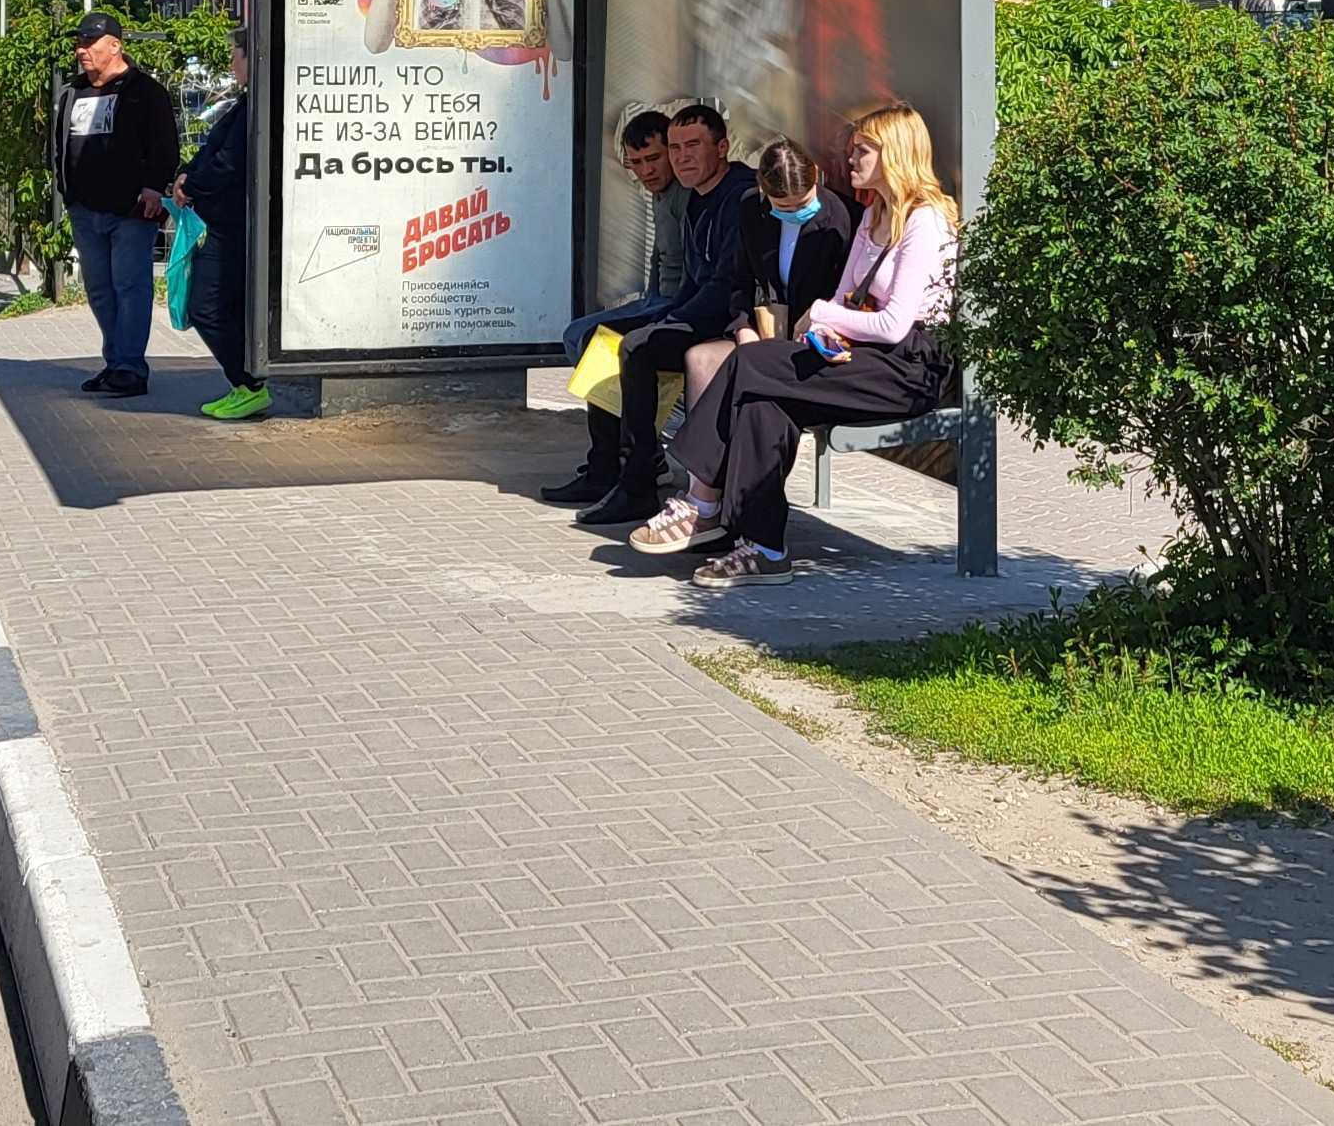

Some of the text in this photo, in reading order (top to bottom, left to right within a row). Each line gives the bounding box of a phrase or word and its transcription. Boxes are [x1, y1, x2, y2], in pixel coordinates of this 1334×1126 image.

[296, 65, 444, 88] РЕШИЛ, ЧТО
[296, 93, 390, 114] КАШЕЛЬ
[402, 93, 414, 114] У
[296, 117, 498, 142] НЕ ИЗ-ЗА ВЕЙПА?
[294, 152, 513, 181] Да брось ты.
[402, 185, 488, 249] ДАВАЙ
[353, 244, 378, 252] РОССИИ
[402, 211, 511, 274] БРОСАТЬ
[402, 279, 490, 292] Присоединяйся
[401, 296, 408, 304] к
[401, 306, 515, 318] Бросишь курить сам
[401, 322, 408, 330] и
[410, 320, 451, 331] другим
